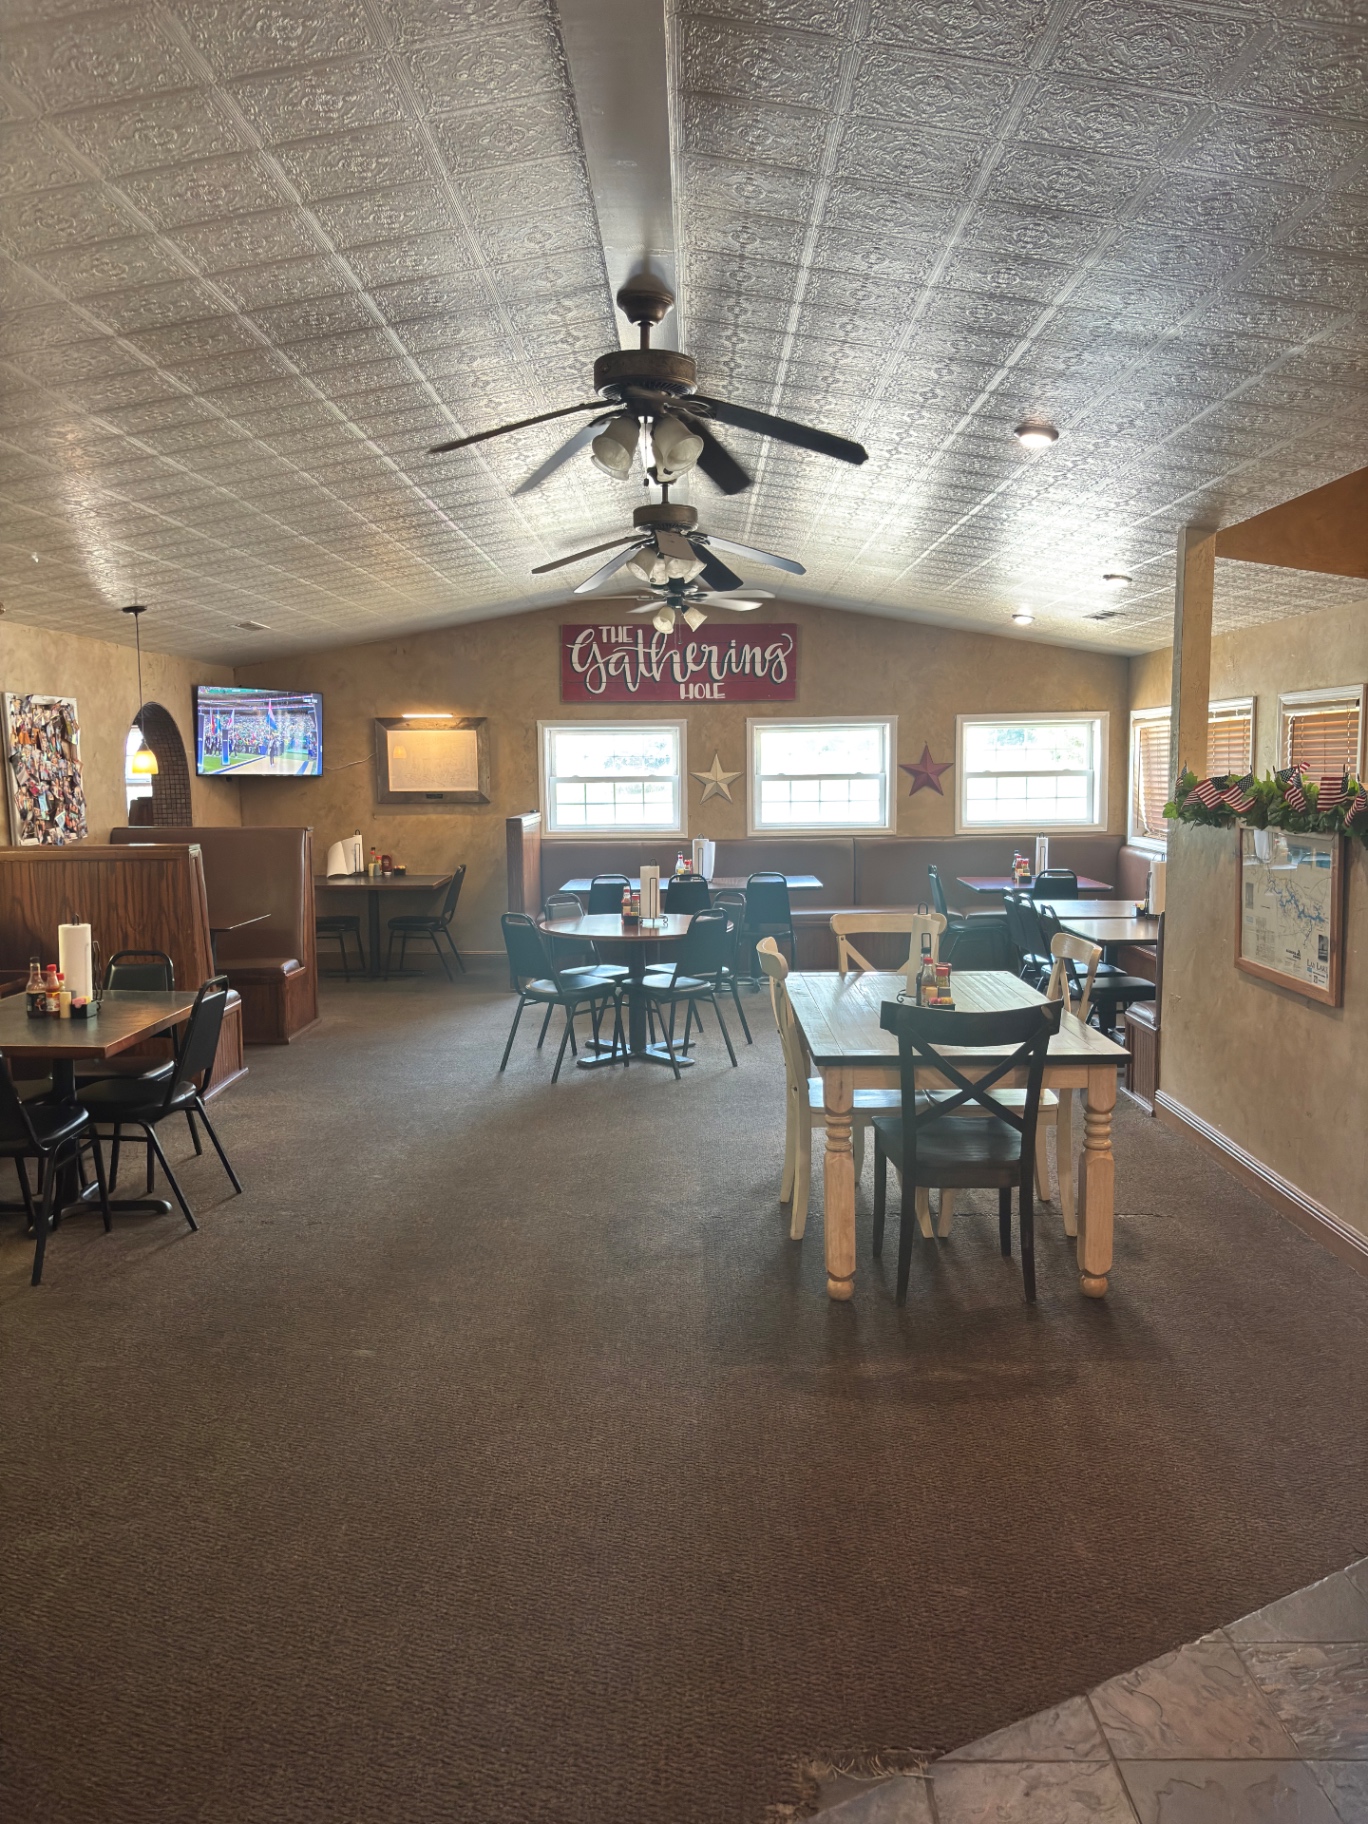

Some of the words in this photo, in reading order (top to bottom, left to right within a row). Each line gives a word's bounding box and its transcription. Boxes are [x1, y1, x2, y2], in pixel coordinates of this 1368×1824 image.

[598, 626, 634, 643] THE
[566, 628, 793, 694] Gathering
[679, 683, 726, 699] HOLE
